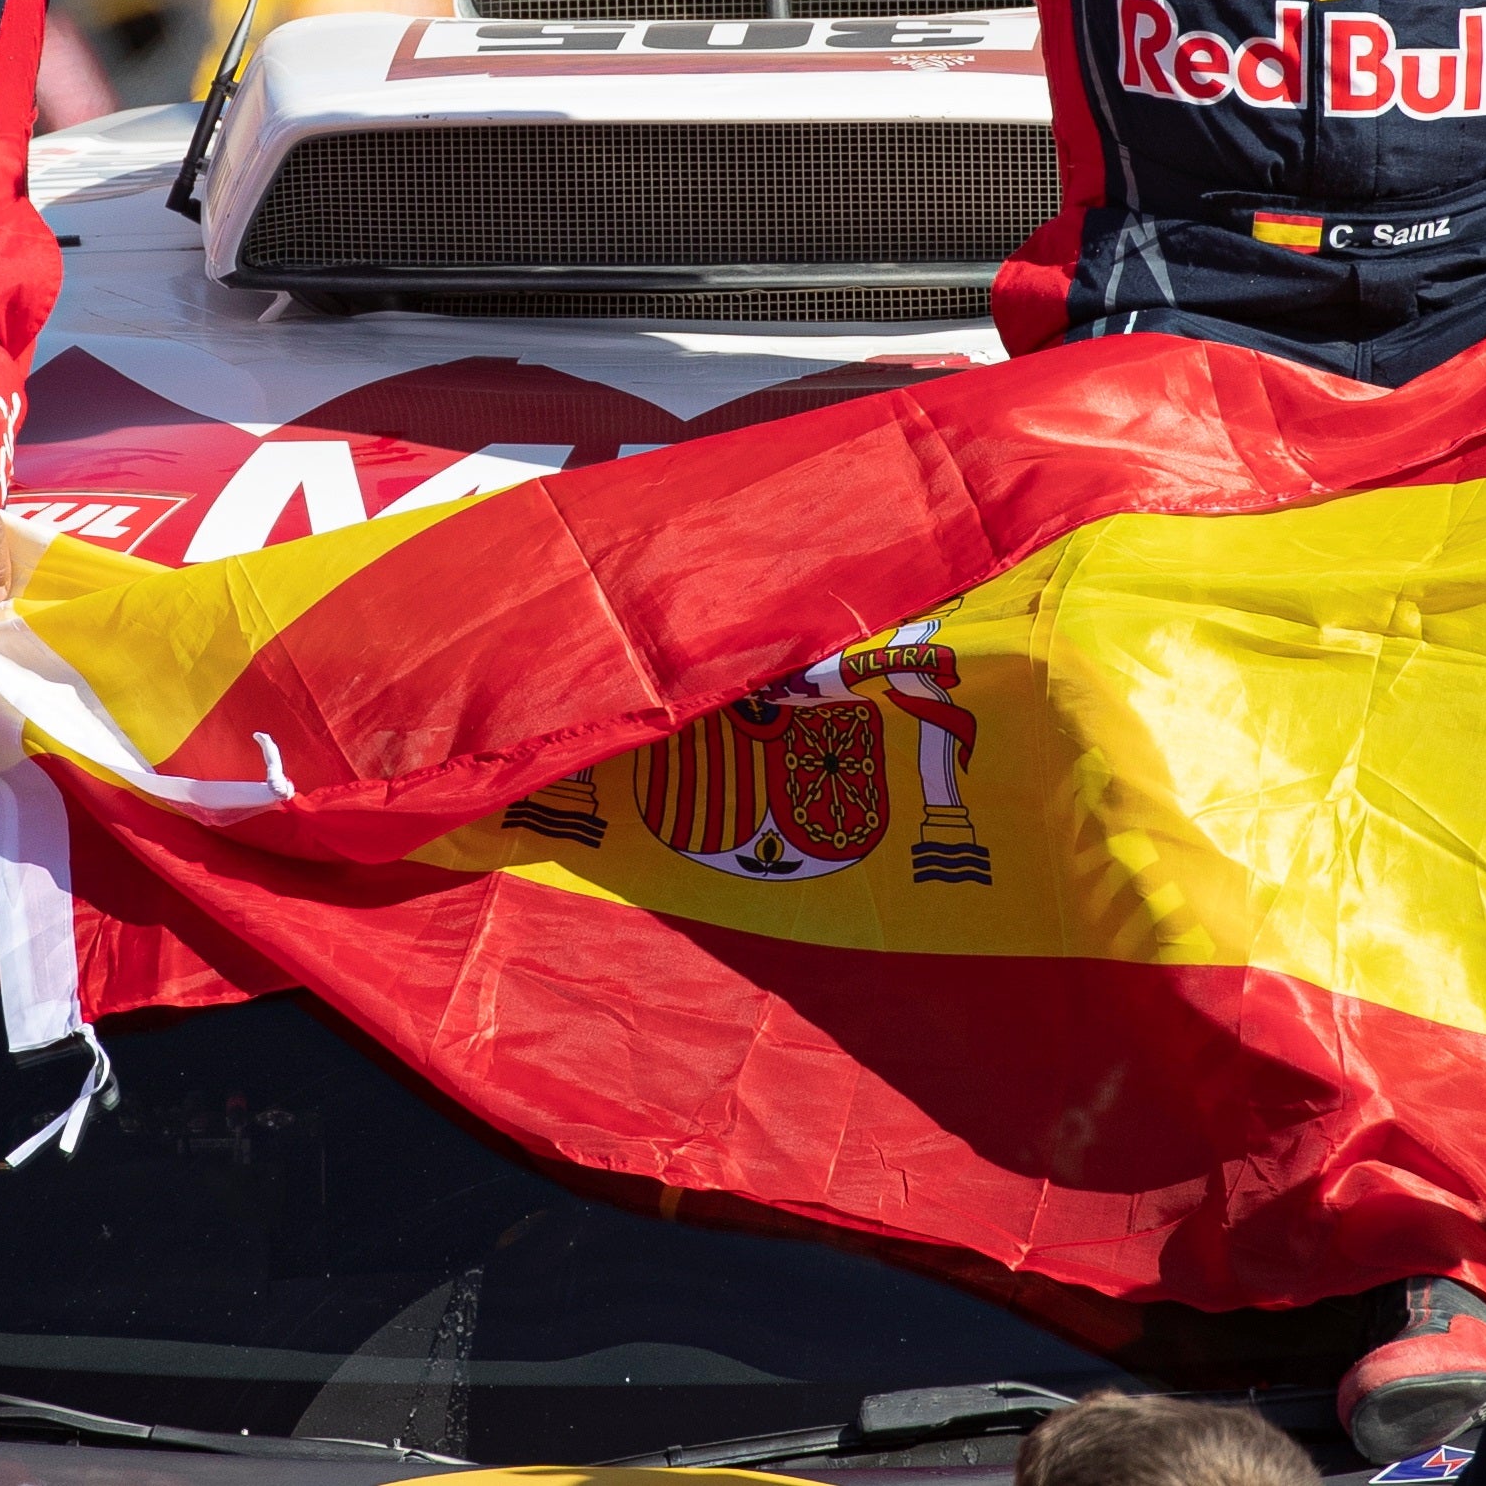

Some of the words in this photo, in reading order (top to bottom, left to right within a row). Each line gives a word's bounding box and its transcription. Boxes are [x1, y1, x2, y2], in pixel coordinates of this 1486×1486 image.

[475, 19, 991, 52] 305
[1328, 224, 1360, 249] C.
[1372, 217, 1452, 246] Sainz
